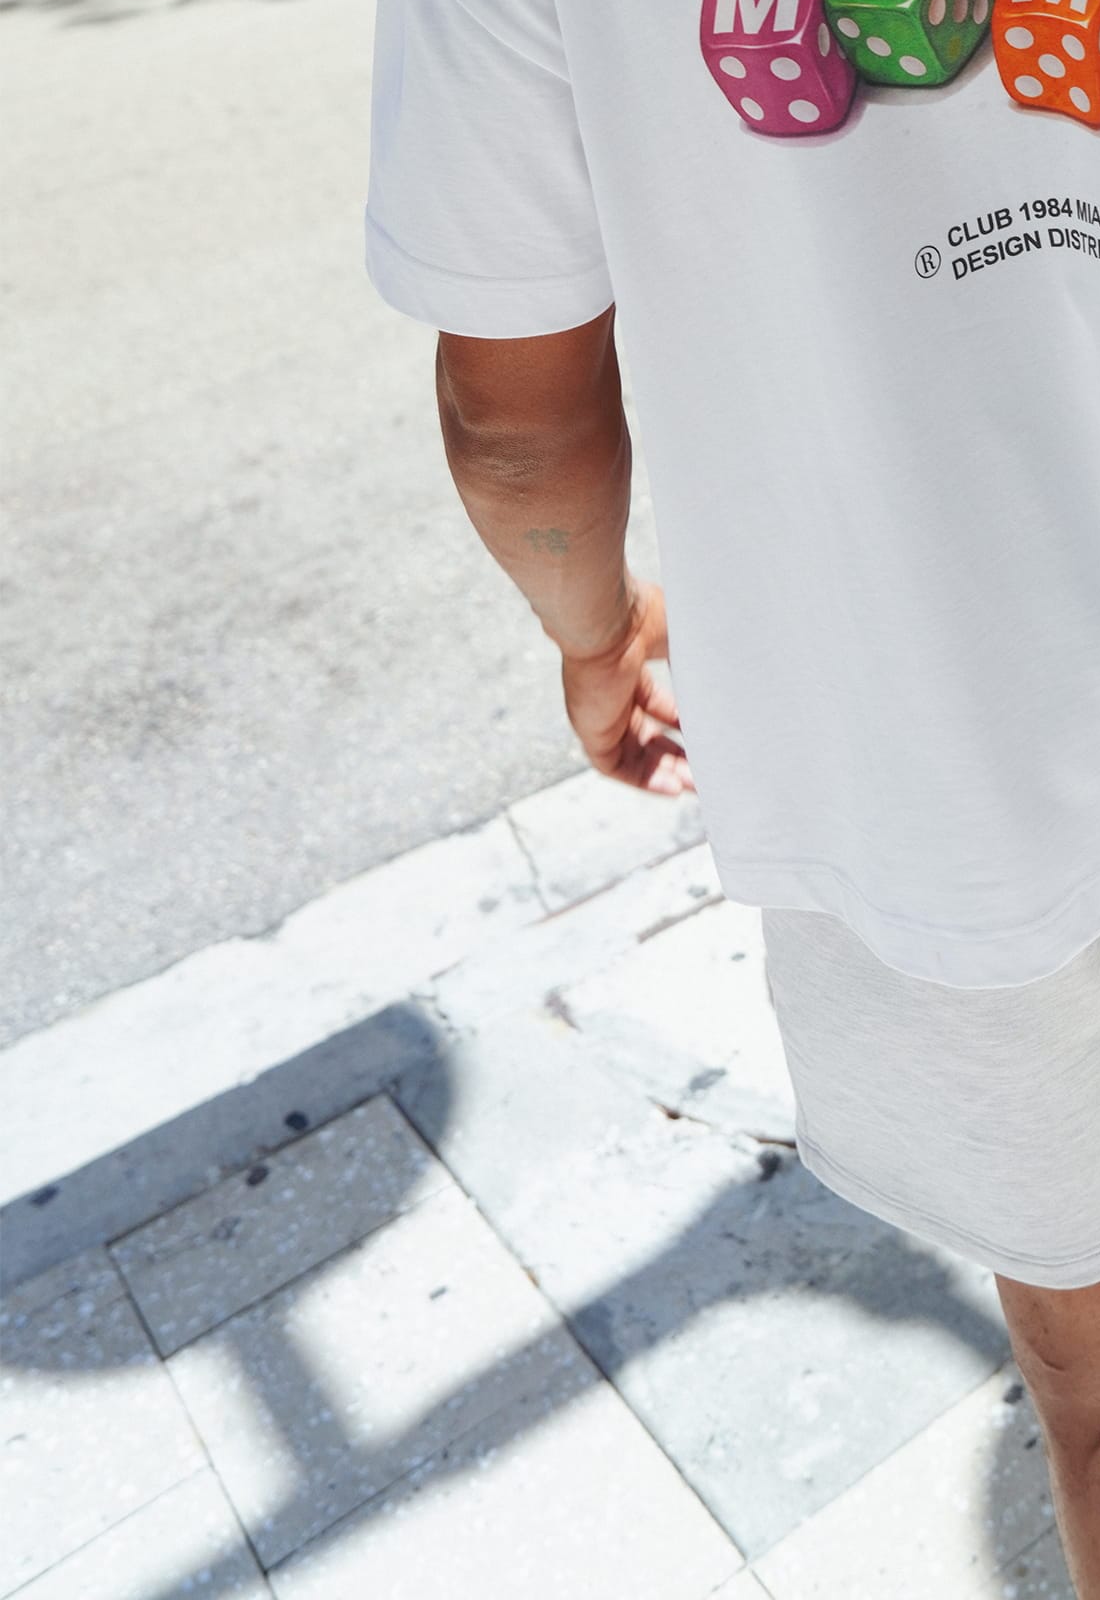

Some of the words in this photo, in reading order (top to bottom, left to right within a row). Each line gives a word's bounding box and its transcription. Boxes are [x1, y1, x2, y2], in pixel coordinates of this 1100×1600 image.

[948, 208, 1013, 247] CLUB
[1019, 198, 1073, 221] 1984
[952, 231, 1042, 280] DESIGN
